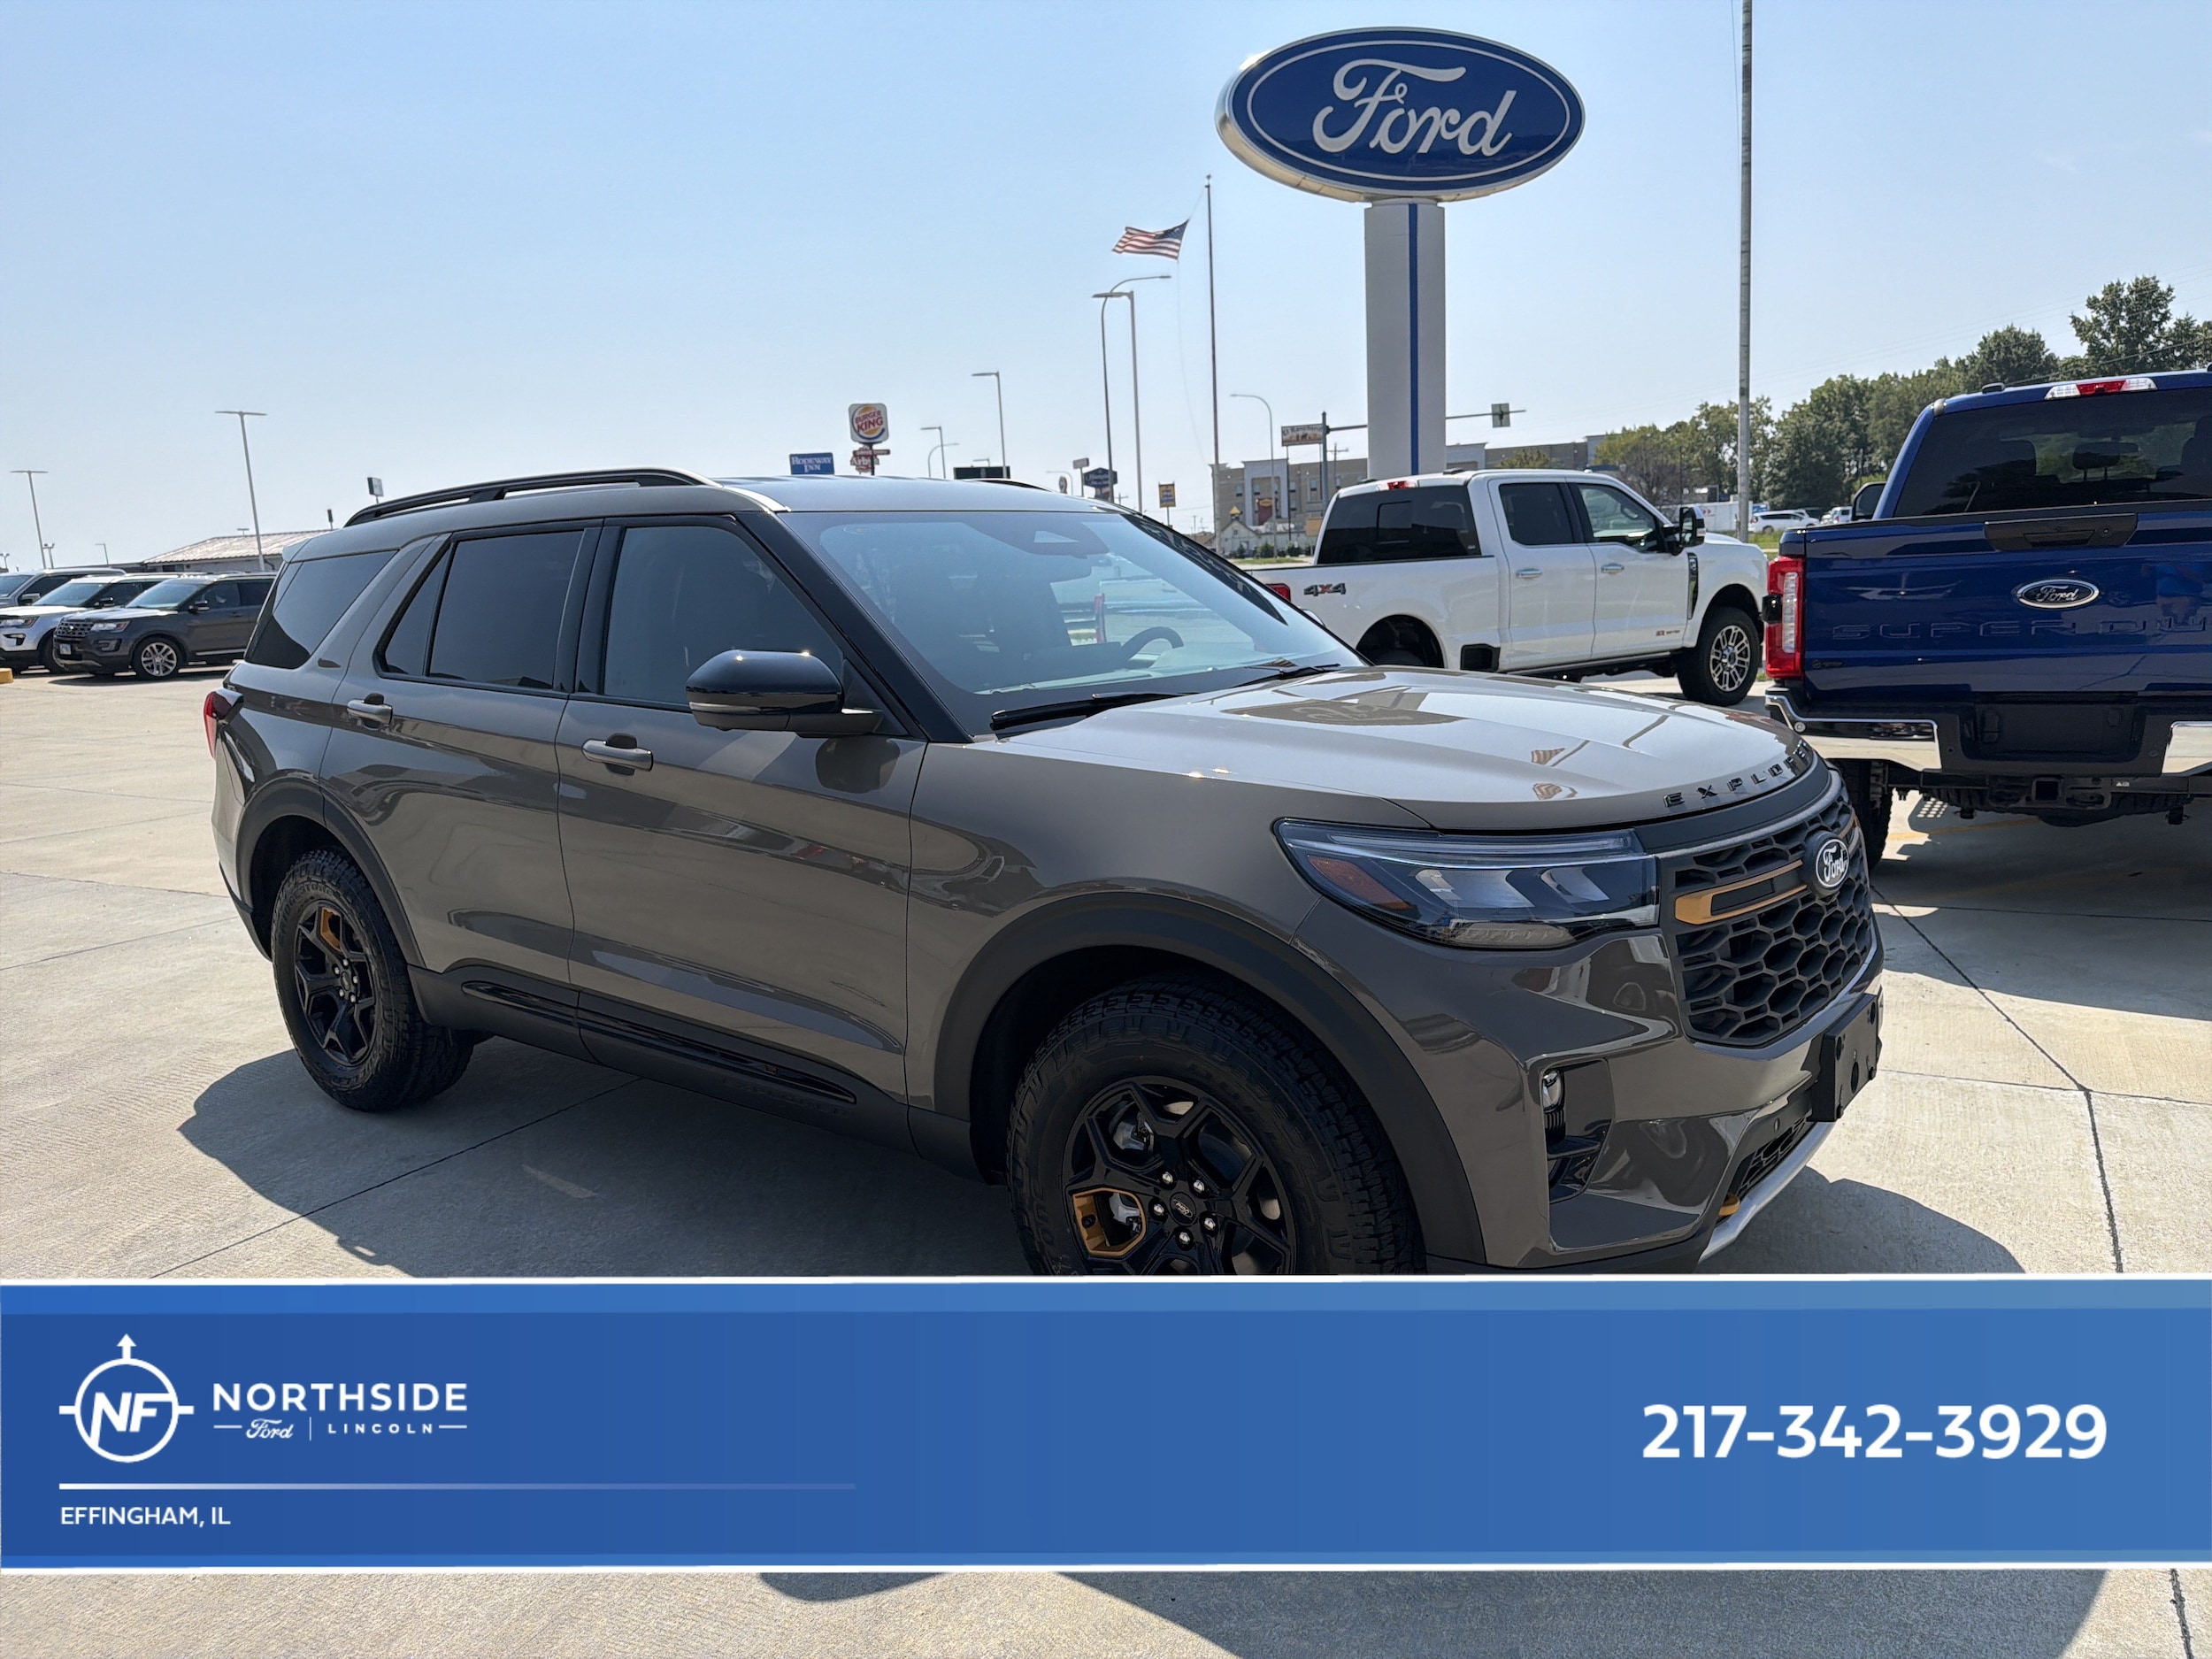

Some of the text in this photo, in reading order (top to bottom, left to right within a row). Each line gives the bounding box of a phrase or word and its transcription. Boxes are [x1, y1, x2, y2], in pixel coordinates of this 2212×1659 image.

[1312, 58, 1517, 157] Ford
[855, 410, 882, 425] BURGER
[856, 416, 884, 433] KING
[791, 457, 832, 465] RODEWAY
[803, 464, 821, 472] INN
[2035, 585, 2079, 602] Ford
[1832, 616, 2207, 641] SUPER DU
[1823, 845, 1847, 882] Ford
